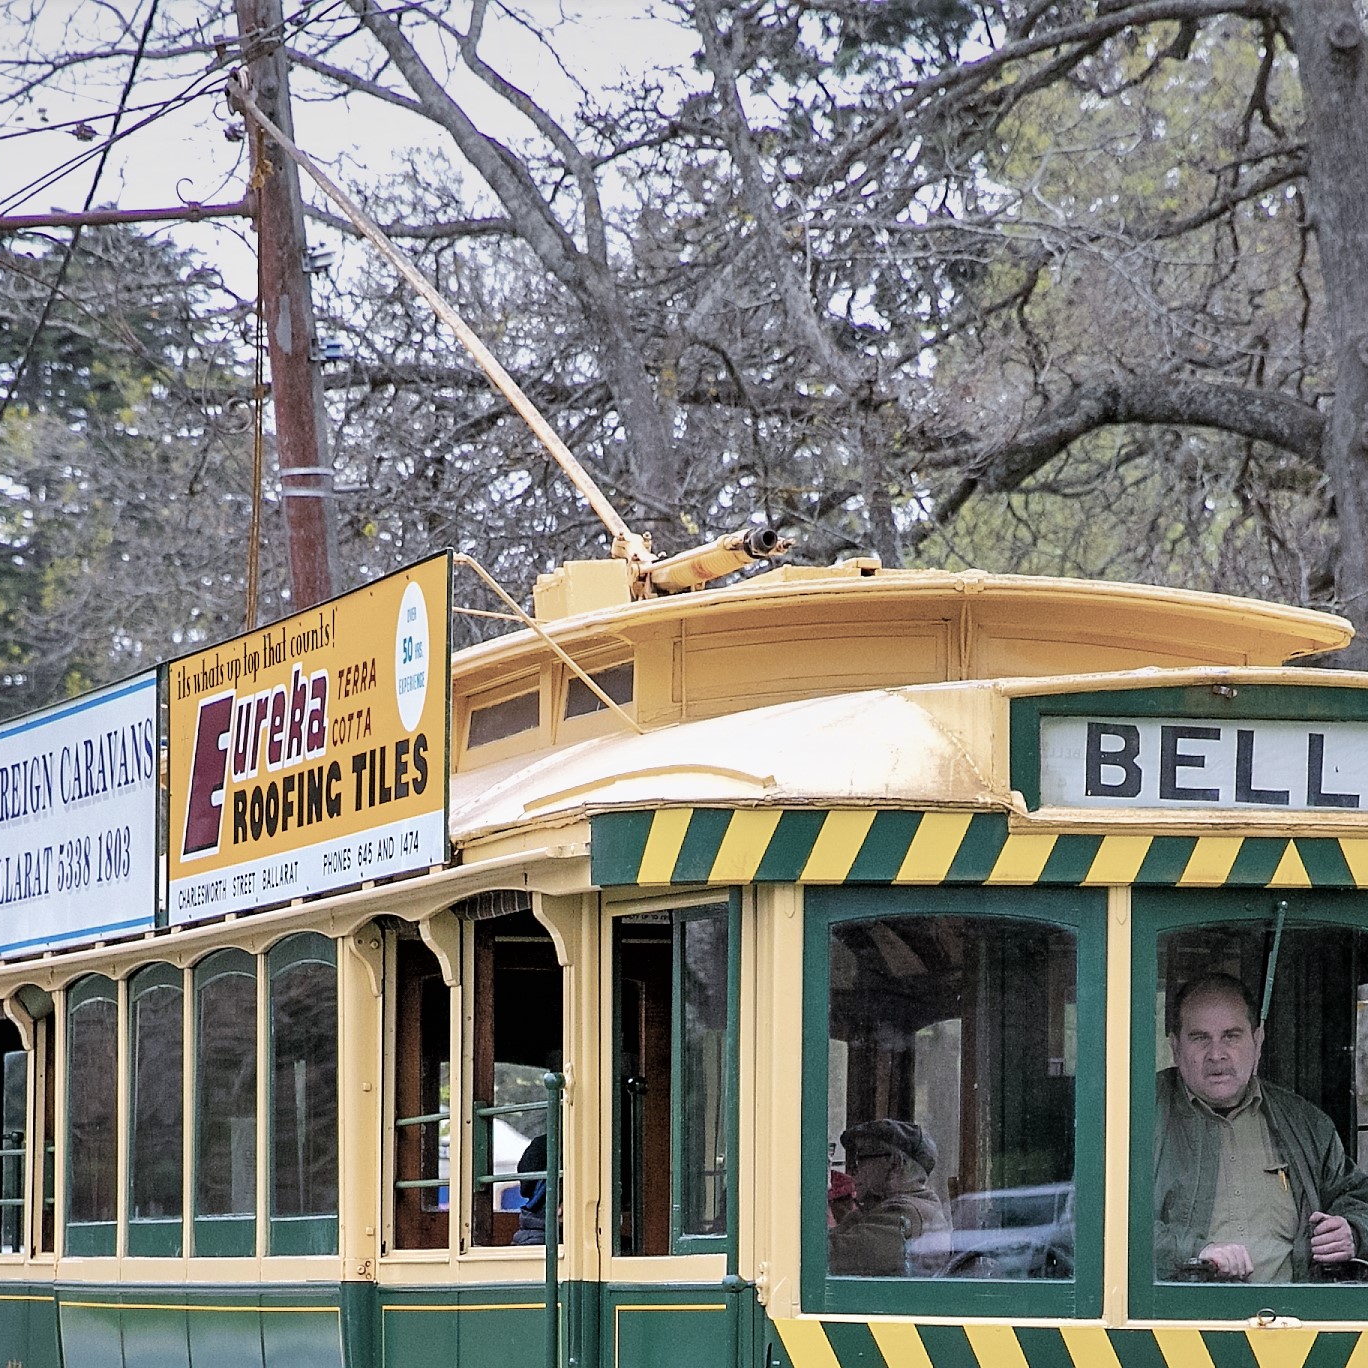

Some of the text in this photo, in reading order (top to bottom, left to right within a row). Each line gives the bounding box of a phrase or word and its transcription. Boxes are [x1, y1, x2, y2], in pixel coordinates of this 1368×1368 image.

[193, 653, 224, 694] whats
[227, 658, 241, 690] up
[243, 642, 260, 683] top
[263, 627, 287, 669] that
[290, 608, 336, 658] counts!
[338, 657, 377, 700] TERRA
[399, 671, 425, 696] EXPERIENCE
[403, 635, 413, 665] 50
[60, 718, 154, 805] CARAVANS
[181, 666, 329, 859] Eureka
[332, 707, 372, 747] COTTA
[233, 733, 429, 845] ROOFING TILES
[57, 836, 92, 891] 5338
[96, 825, 131, 882] 1803
[178, 830, 420, 910] CHARLESWORTH STREET BALLARAT PHONES 645 AND 1474
